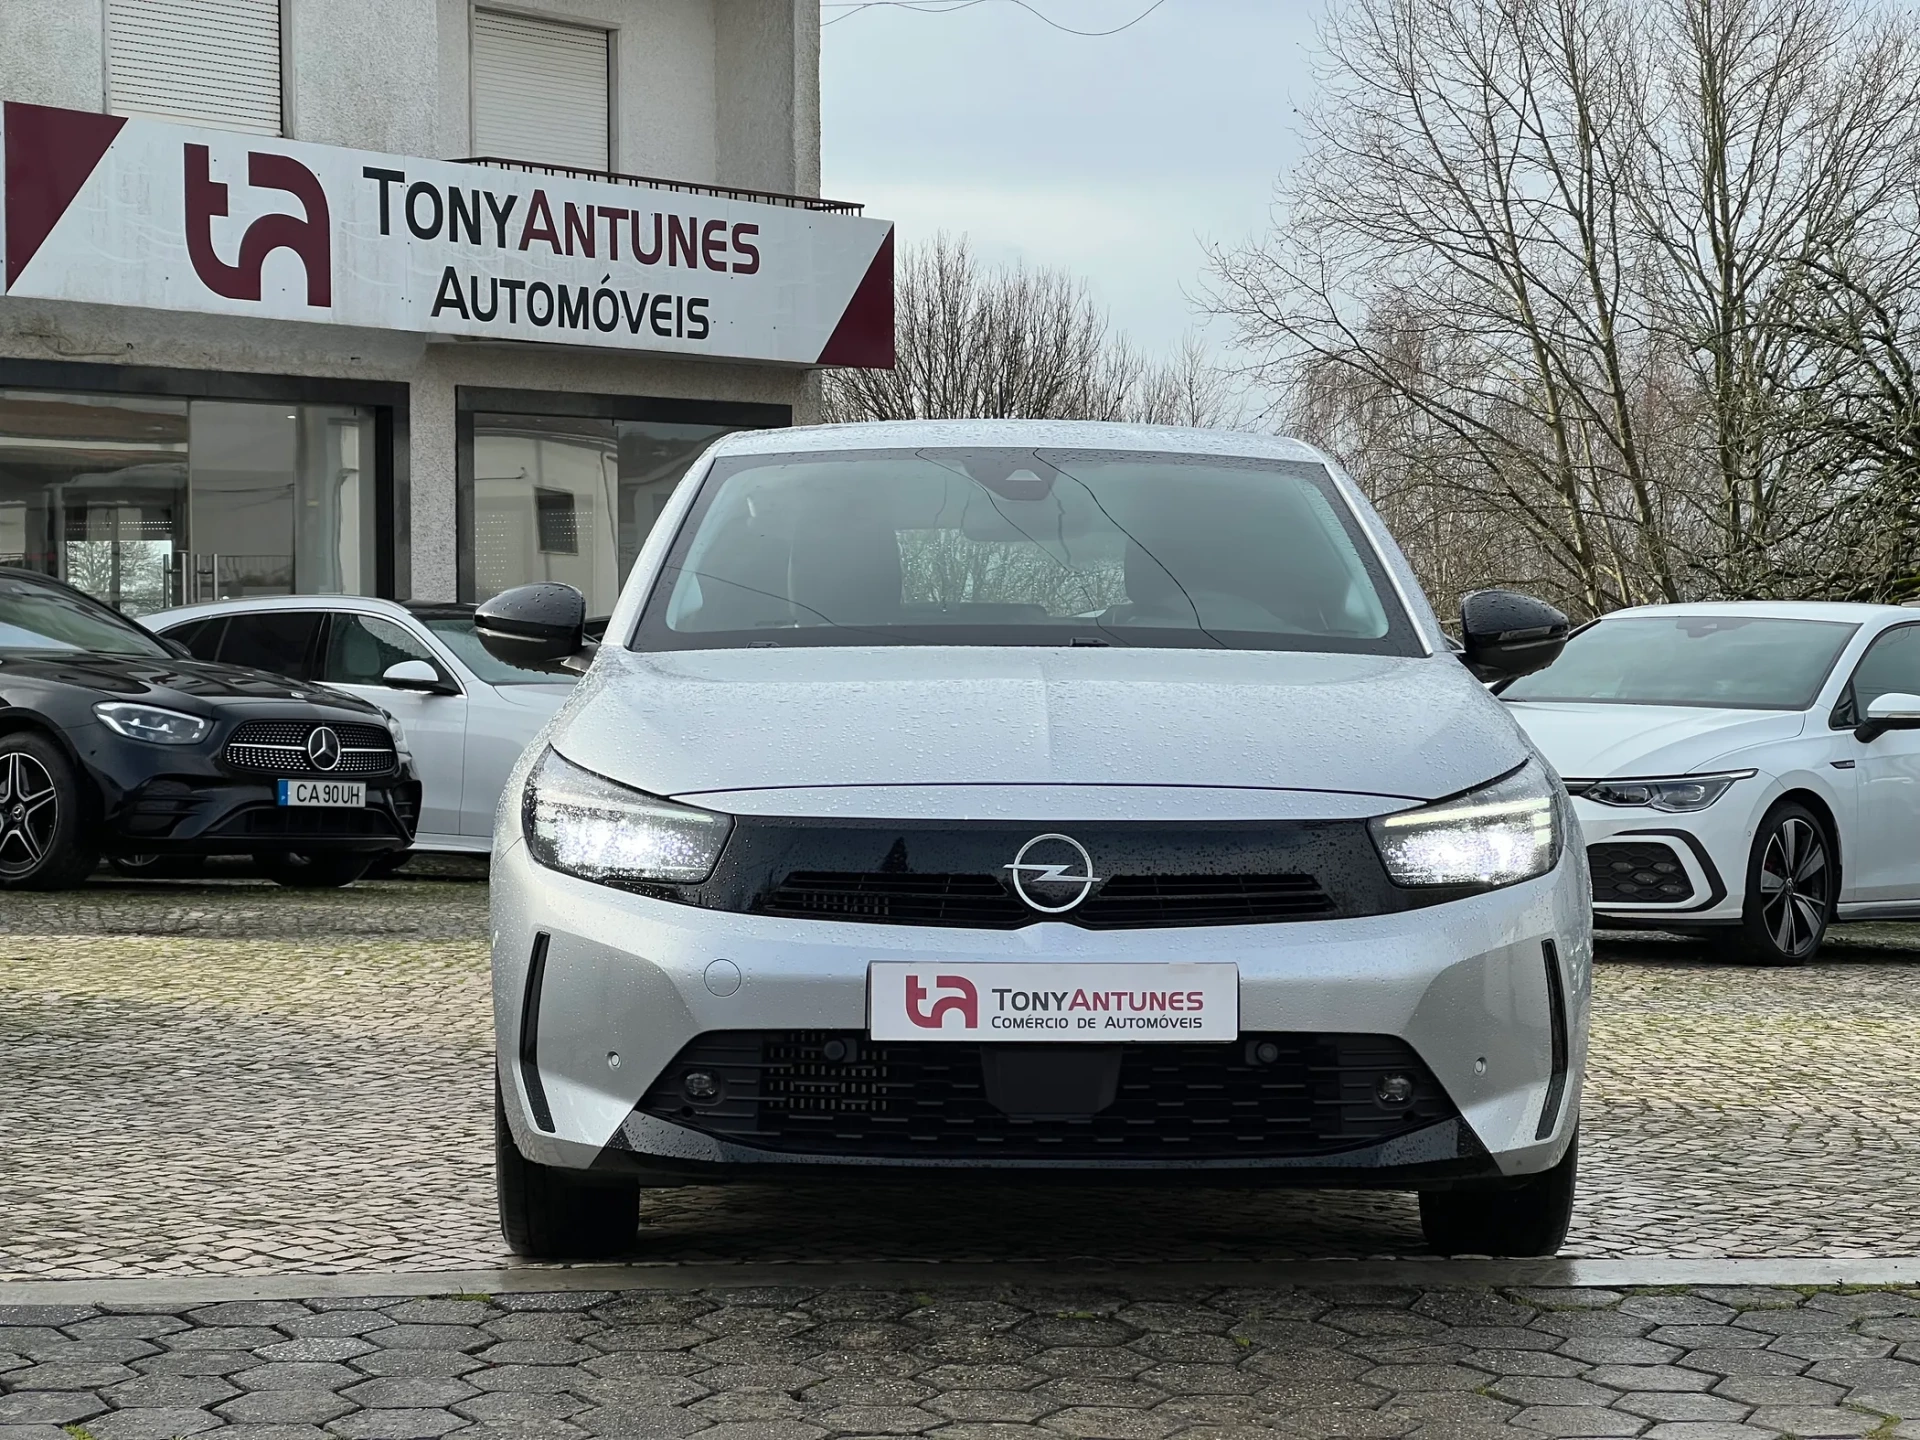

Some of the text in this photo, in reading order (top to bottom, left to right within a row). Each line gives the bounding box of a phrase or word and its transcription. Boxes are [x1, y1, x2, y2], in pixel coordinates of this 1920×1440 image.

[431, 266, 710, 340] AUTOMÓVEIS
[991, 1014, 1203, 1030] COMÉRCIO DE AUTOMÓVEIS
